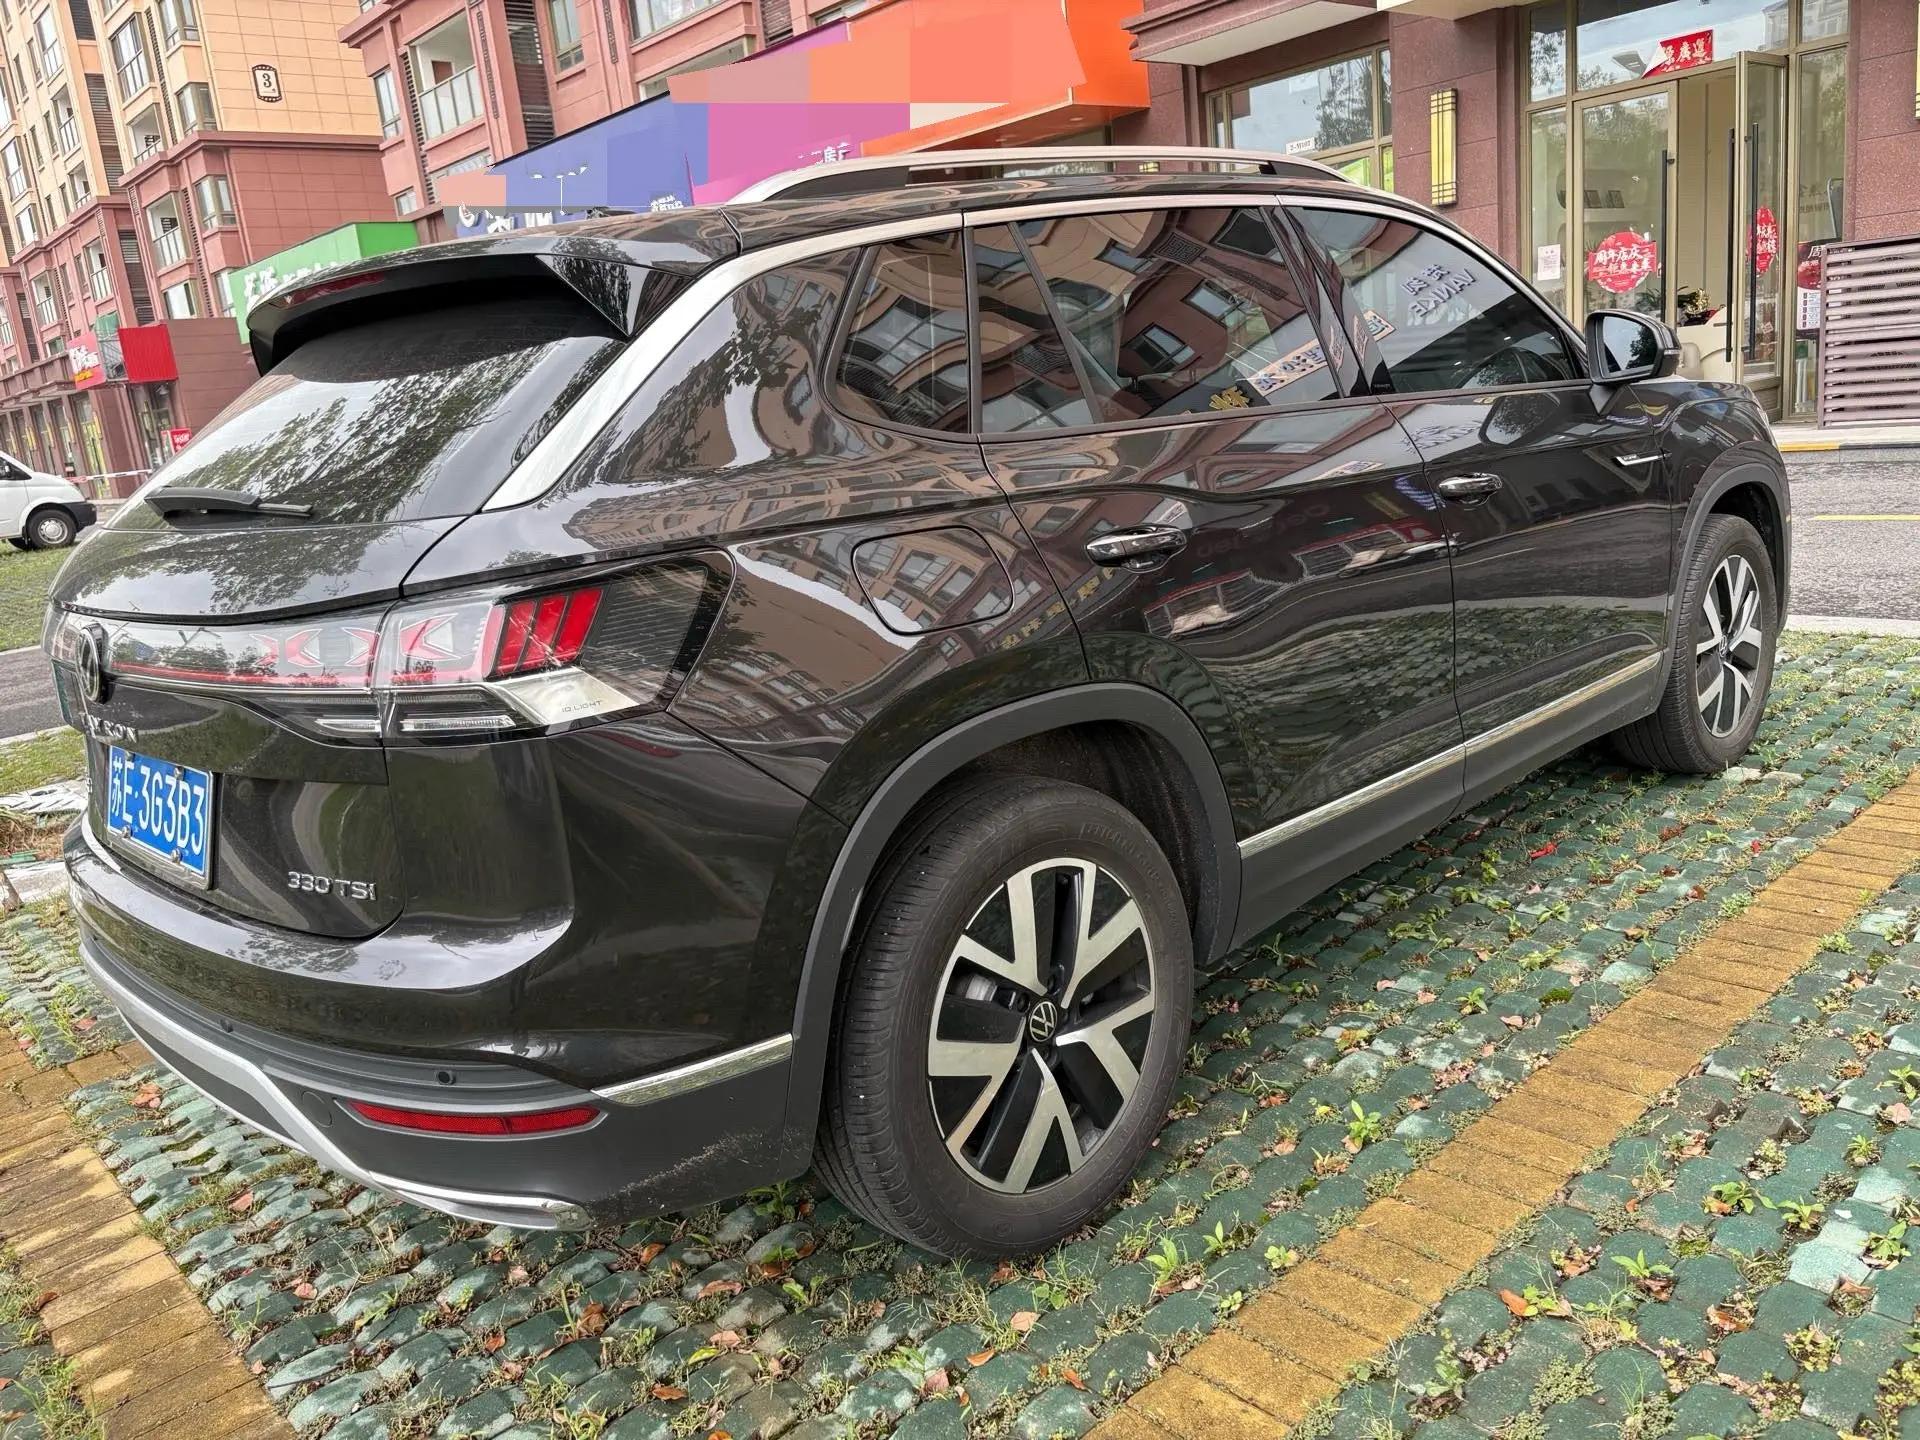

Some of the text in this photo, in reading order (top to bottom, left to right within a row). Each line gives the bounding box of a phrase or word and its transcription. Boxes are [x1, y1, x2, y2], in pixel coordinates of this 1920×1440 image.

[262, 73, 273, 88] 3
[287, 871, 377, 901] 330 TSI
